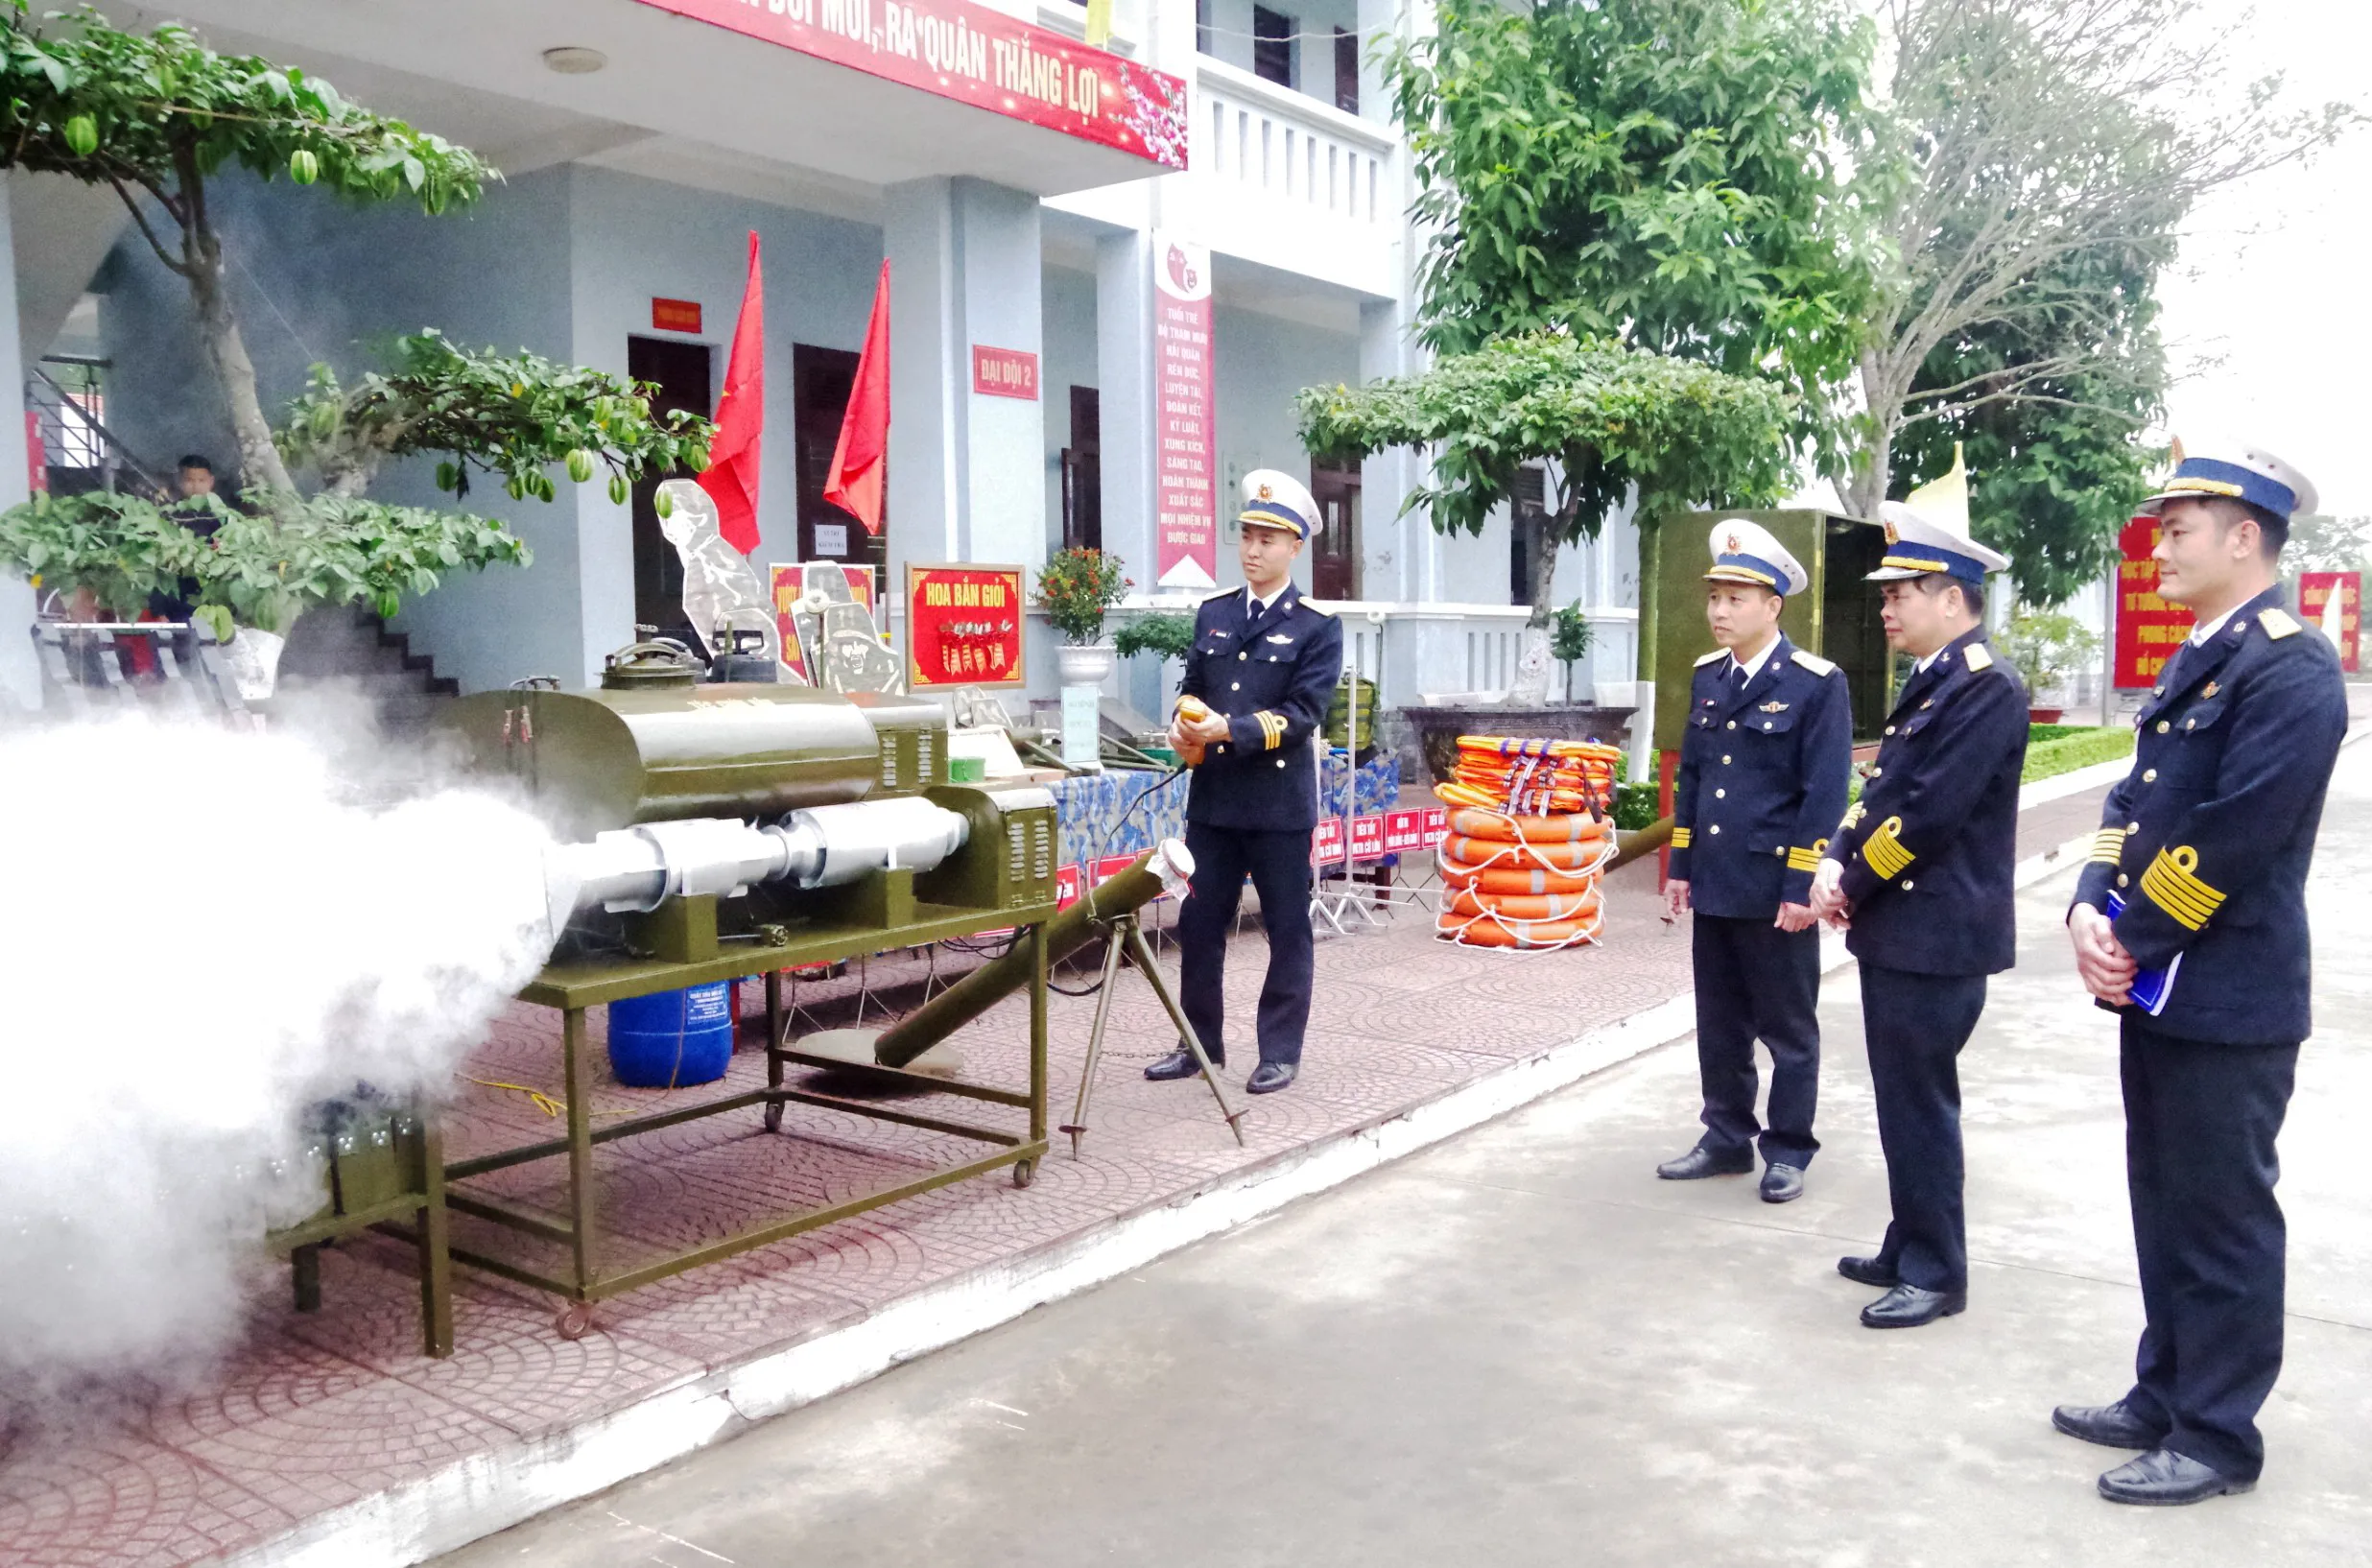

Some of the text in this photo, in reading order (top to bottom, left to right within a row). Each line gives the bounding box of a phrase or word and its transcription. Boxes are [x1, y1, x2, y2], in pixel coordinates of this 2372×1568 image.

[885, 0, 918, 60] RA
[923, 15, 987, 83] QUÂN
[992, 31, 1063, 107] THẮNG
[1067, 62, 1099, 126] LỢI
[1024, 365, 1032, 387] 2
[1164, 438, 1186, 451] XUNG
[1167, 456, 1188, 470] SÁNG
[925, 575, 1006, 607] HOA BẮN GIỎI
